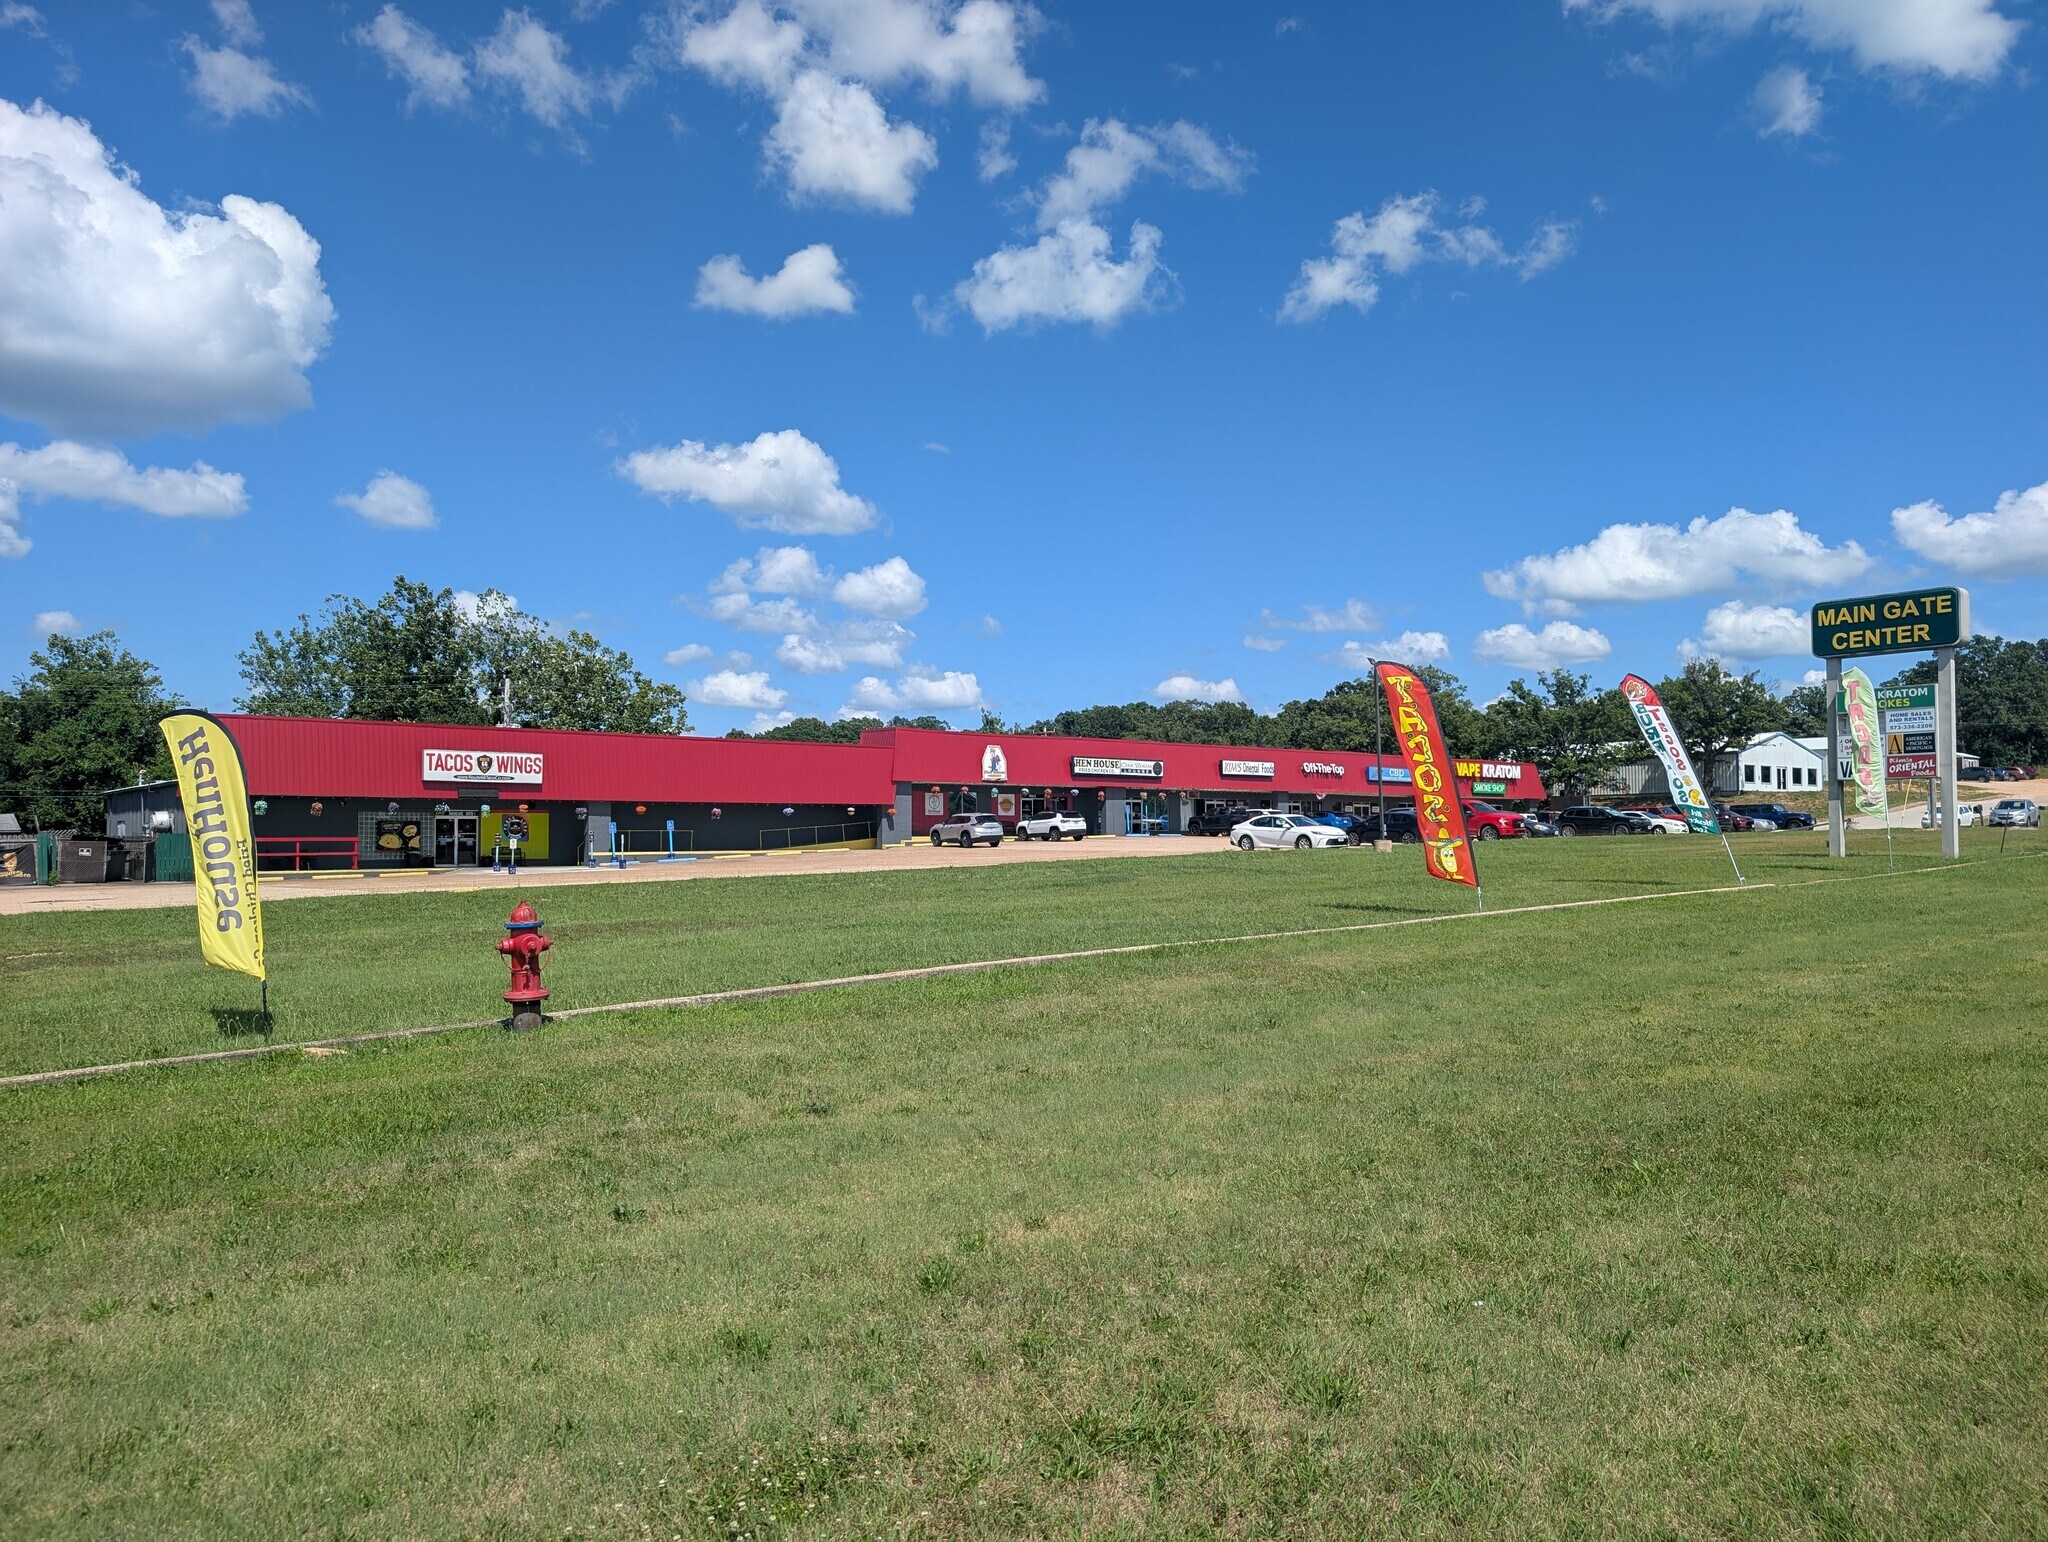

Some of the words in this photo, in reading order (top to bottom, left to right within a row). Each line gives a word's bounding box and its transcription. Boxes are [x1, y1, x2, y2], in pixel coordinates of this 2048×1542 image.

[1817, 603, 1876, 627] MAIN
[1883, 594, 1952, 620] GATE
[1832, 623, 1931, 650] CENTER
[1877, 687, 1928, 699] KRATOM
[1878, 698, 1911, 709] OKES
[426, 753, 473, 772] TACOS
[496, 755, 542, 775] WINGS
[1075, 758, 1092, 768] HEN
[1093, 759, 1120, 769] HOUSE
[1261, 763, 1275, 774] Foods
[1889, 759, 1936, 774] ORIENTAL
[1389, 768, 1404, 777] CBD
[1455, 762, 1481, 777] VAPE
[1482, 763, 1521, 779] KRATOM
[1474, 783, 1491, 792] SMOKE
[1491, 784, 1506, 793] SHOP
